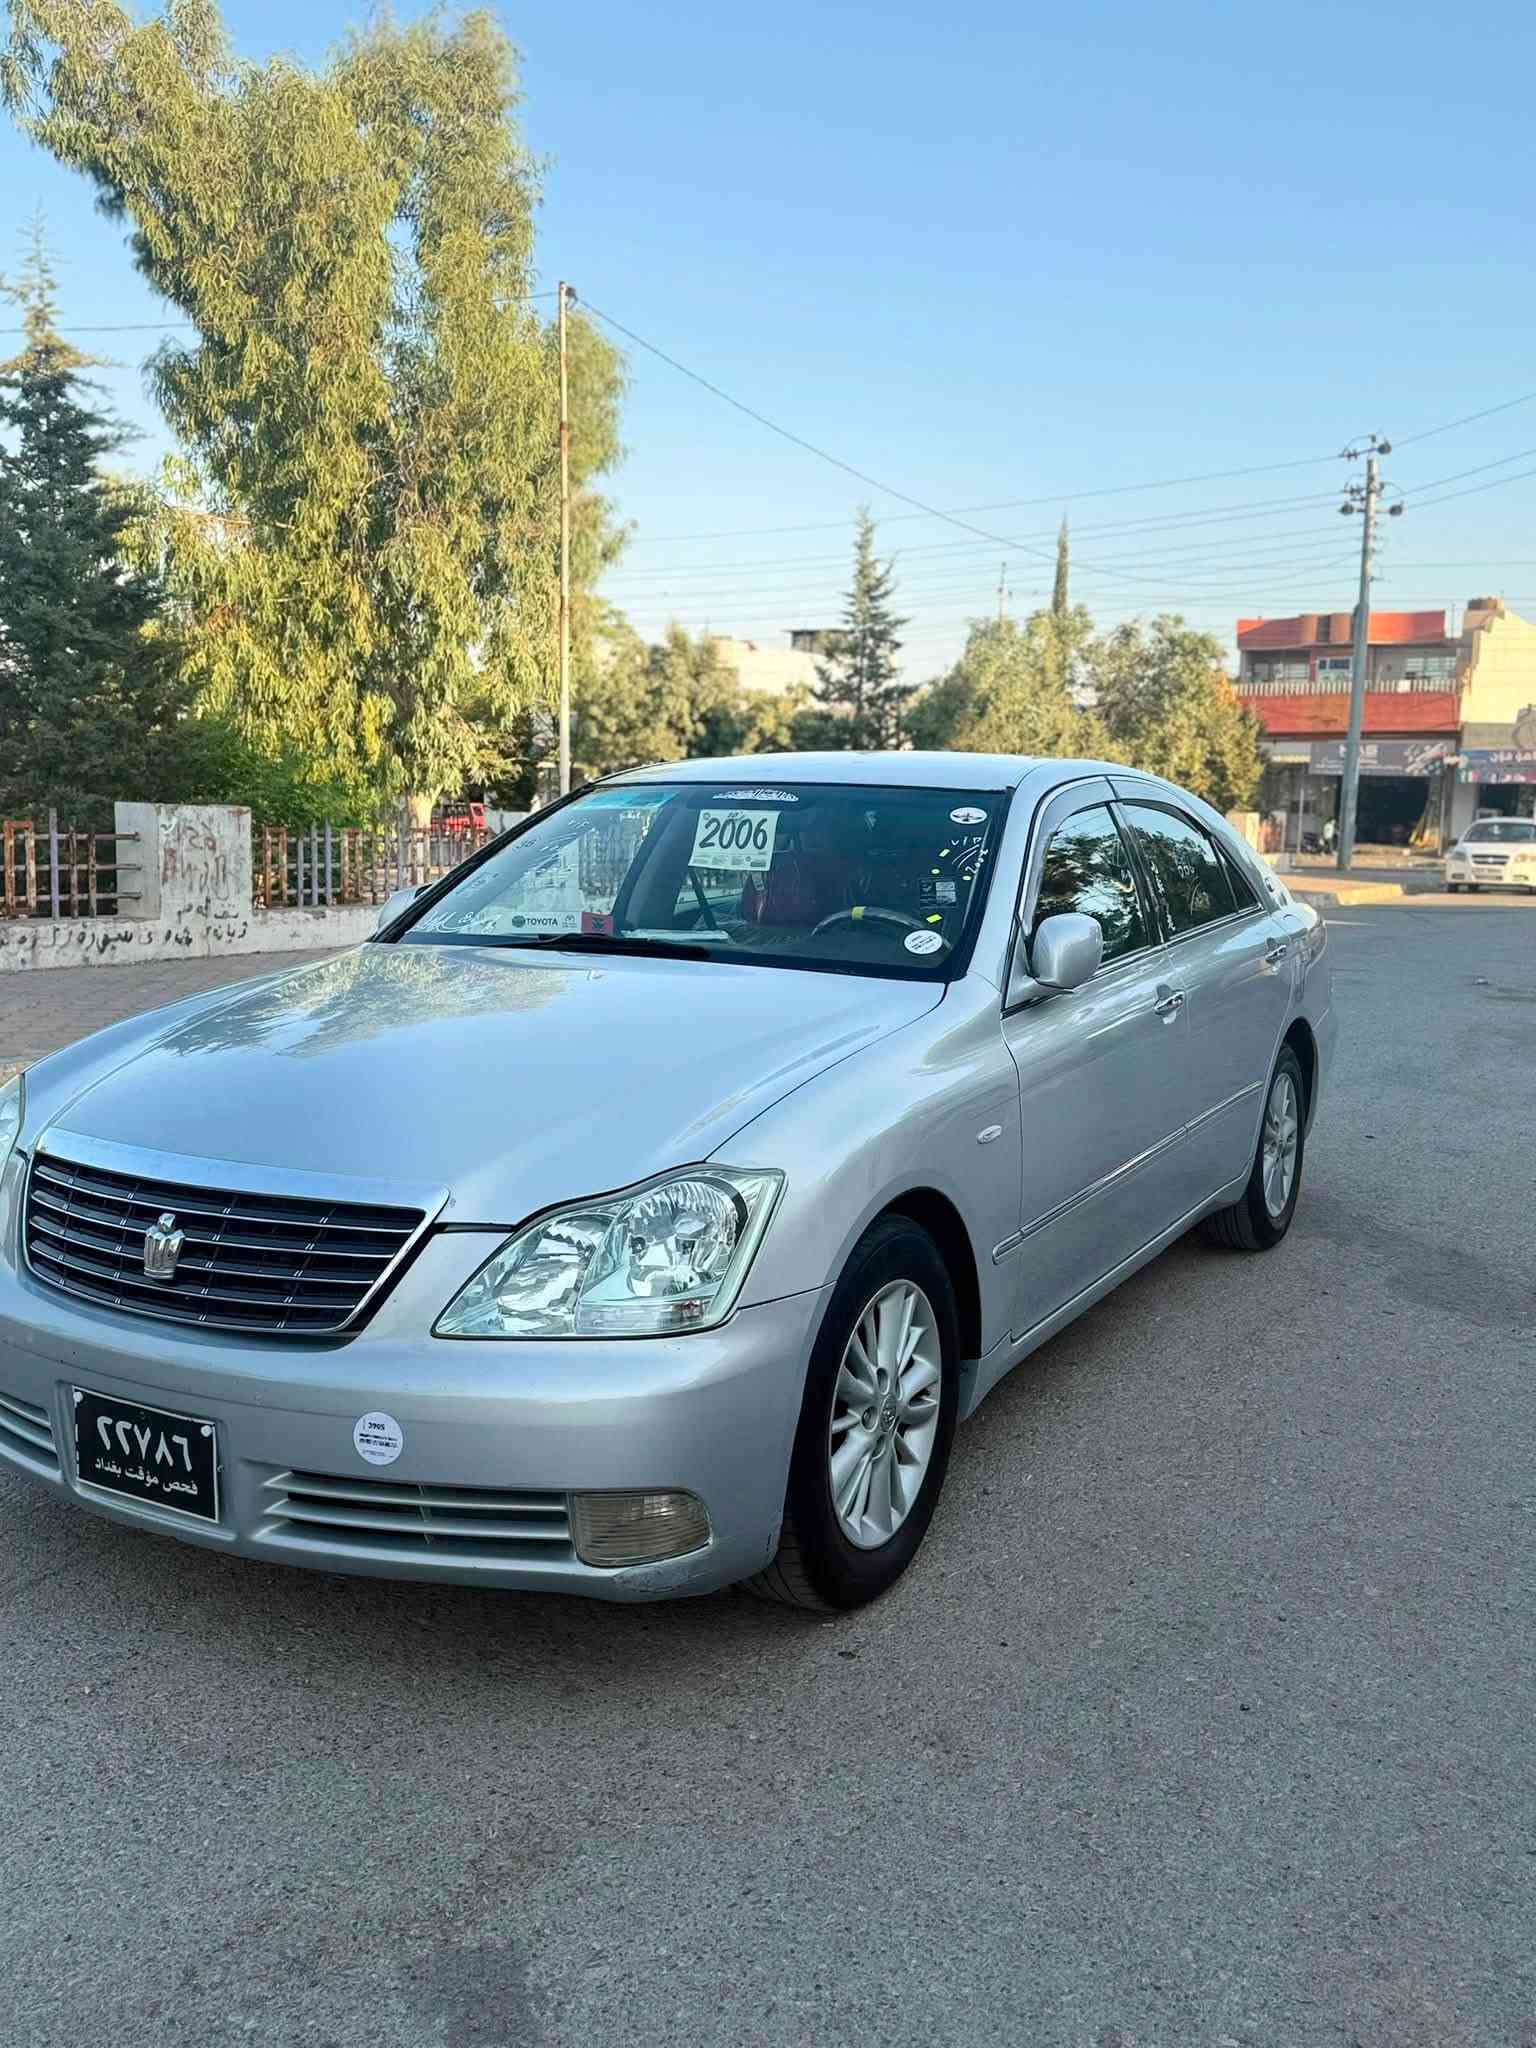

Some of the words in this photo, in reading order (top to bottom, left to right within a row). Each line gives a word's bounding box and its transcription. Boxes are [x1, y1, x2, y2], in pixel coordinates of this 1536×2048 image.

[699, 817, 768, 850] 2006
[526, 917, 559, 927] TOYOTA
[97, 1416, 192, 1472] ٢٢٧٨٦
[95, 1458, 122, 1478] بغداد
[125, 1465, 159, 1487] مؤقت
[162, 1480, 198, 1495] فحص
